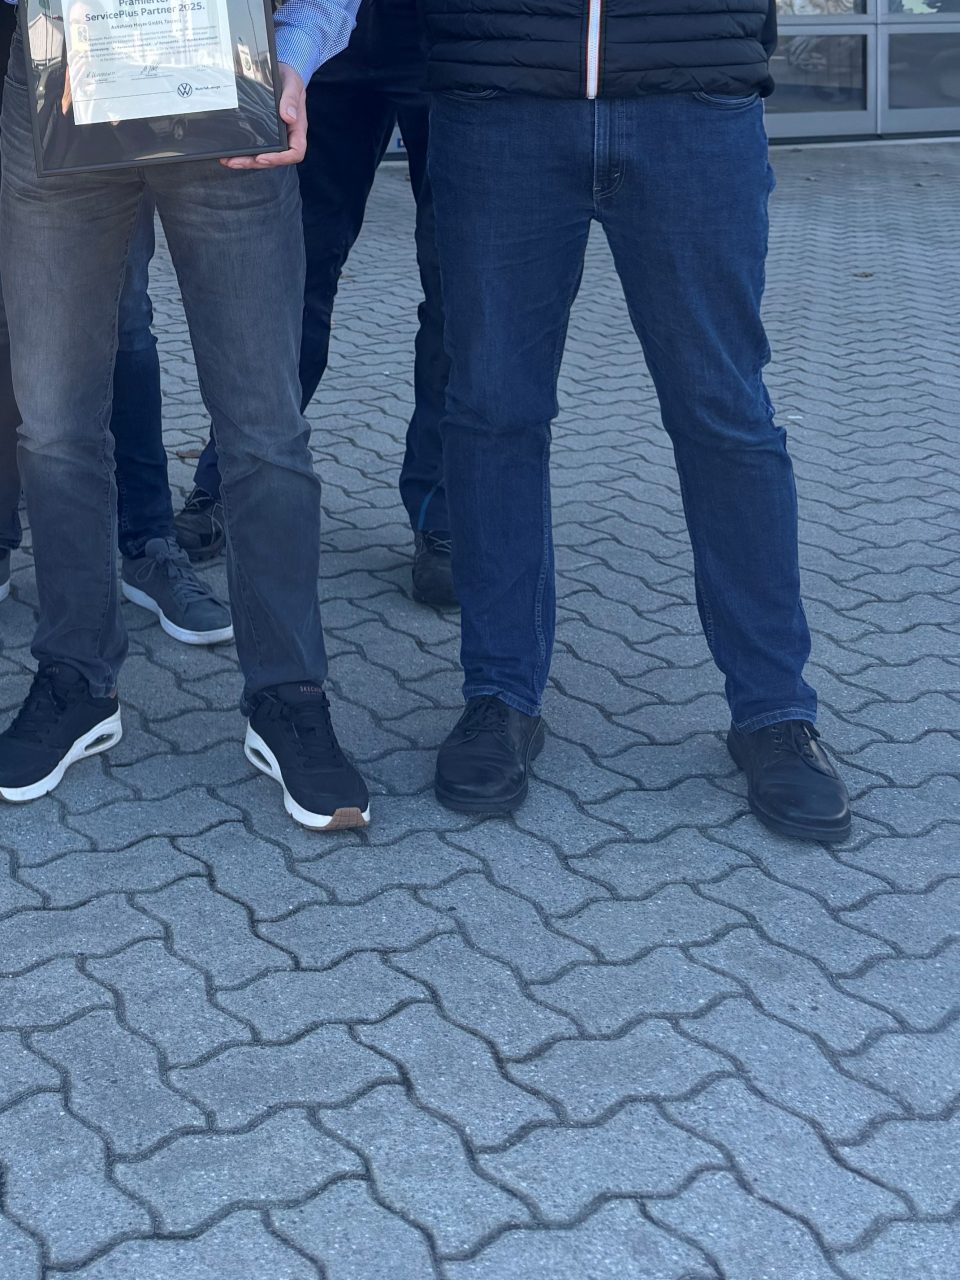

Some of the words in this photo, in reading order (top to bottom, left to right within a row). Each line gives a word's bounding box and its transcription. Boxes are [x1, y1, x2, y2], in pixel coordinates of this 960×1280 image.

[85, 9, 139, 22] ServicePlus
[140, 6, 177, 16] Partner
[178, 1, 206, 12] 2025.
